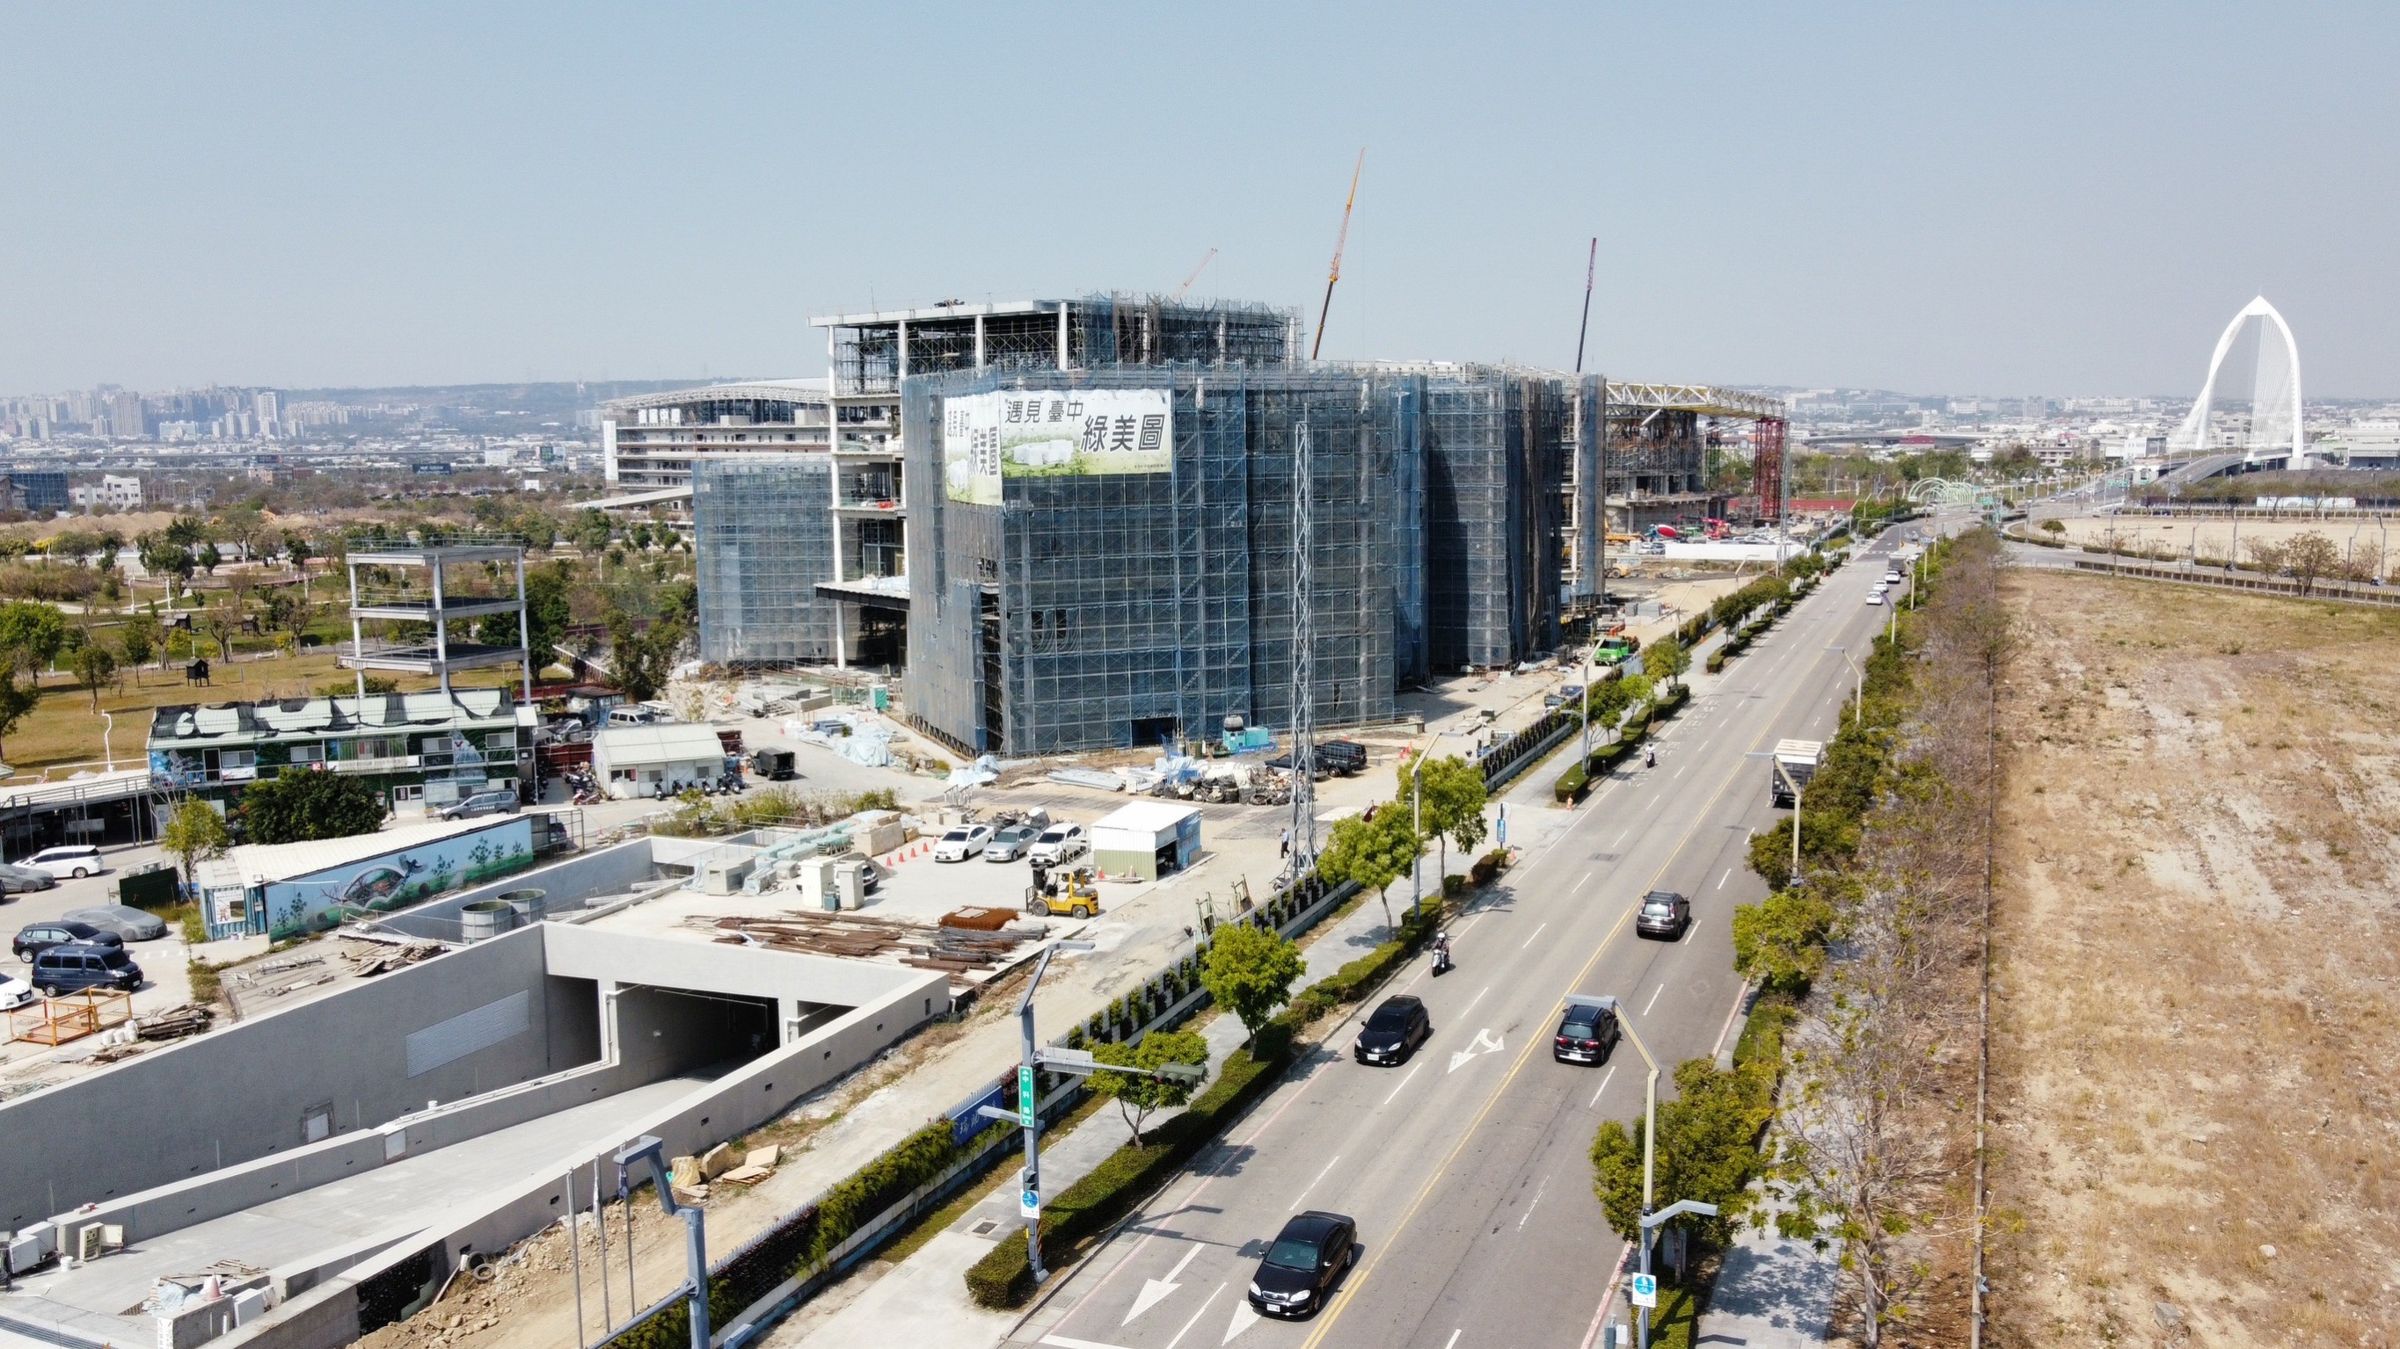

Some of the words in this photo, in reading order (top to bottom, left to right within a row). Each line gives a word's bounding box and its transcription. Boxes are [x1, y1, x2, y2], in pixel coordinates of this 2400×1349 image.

[1005, 400, 1041, 424] 遇見
[1048, 400, 1084, 423] 臺中
[1080, 414, 1165, 452] 綠美圖
